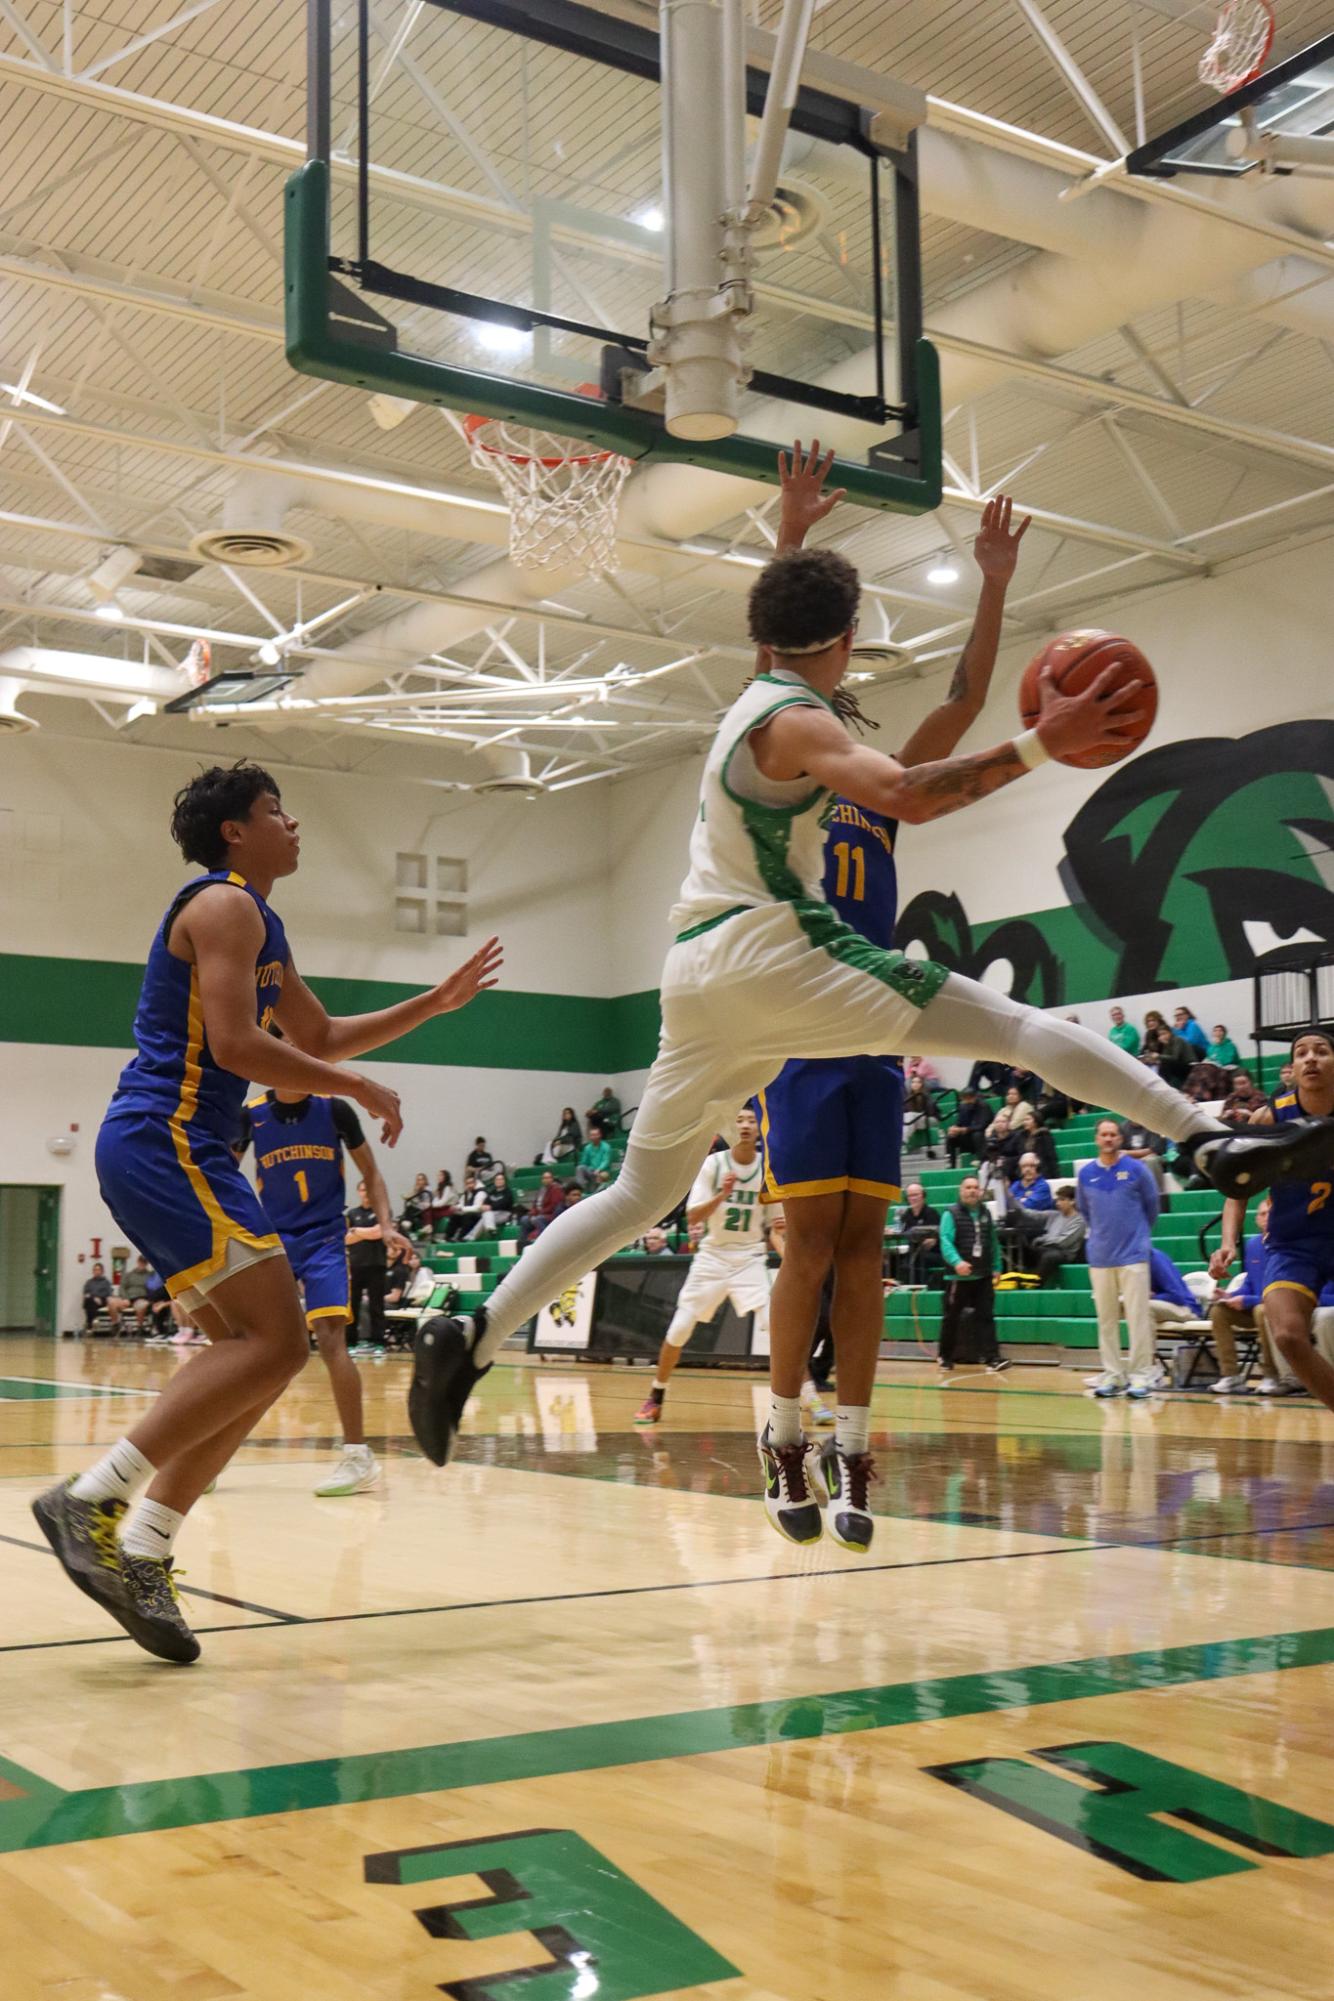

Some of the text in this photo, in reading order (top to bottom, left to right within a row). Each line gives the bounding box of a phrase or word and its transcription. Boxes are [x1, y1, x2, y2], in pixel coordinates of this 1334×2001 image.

[833, 841, 865, 901] 11
[293, 1170, 309, 1203] 1
[724, 1207, 753, 1232] 21
